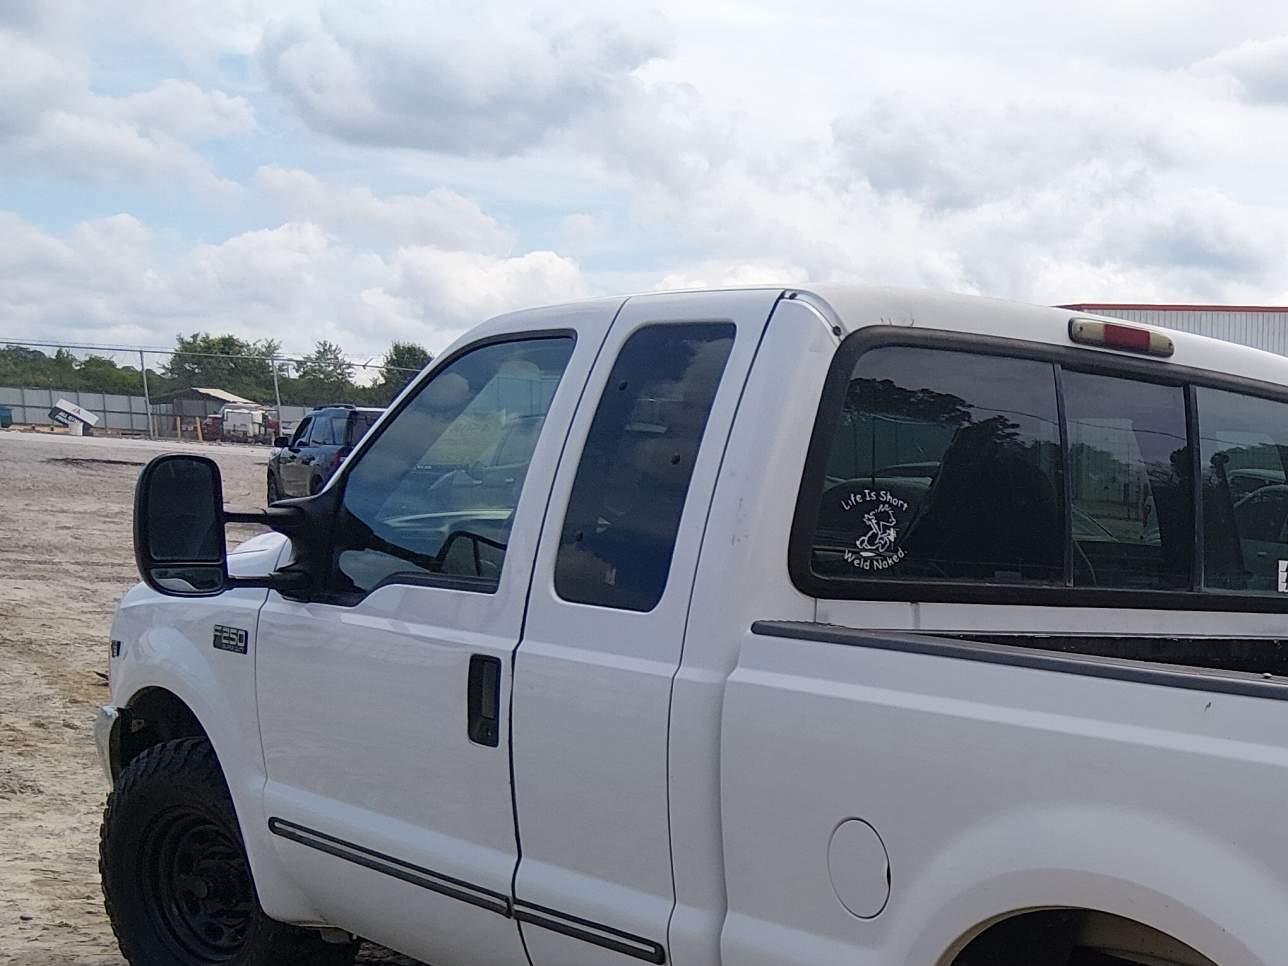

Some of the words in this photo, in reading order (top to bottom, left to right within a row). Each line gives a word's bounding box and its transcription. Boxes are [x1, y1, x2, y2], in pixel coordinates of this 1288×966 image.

[841, 493, 863, 510] Life
[864, 489, 876, 501] Is
[880, 490, 908, 511] Short
[844, 548, 870, 570] Weld
[873, 547, 905, 570] Naked
